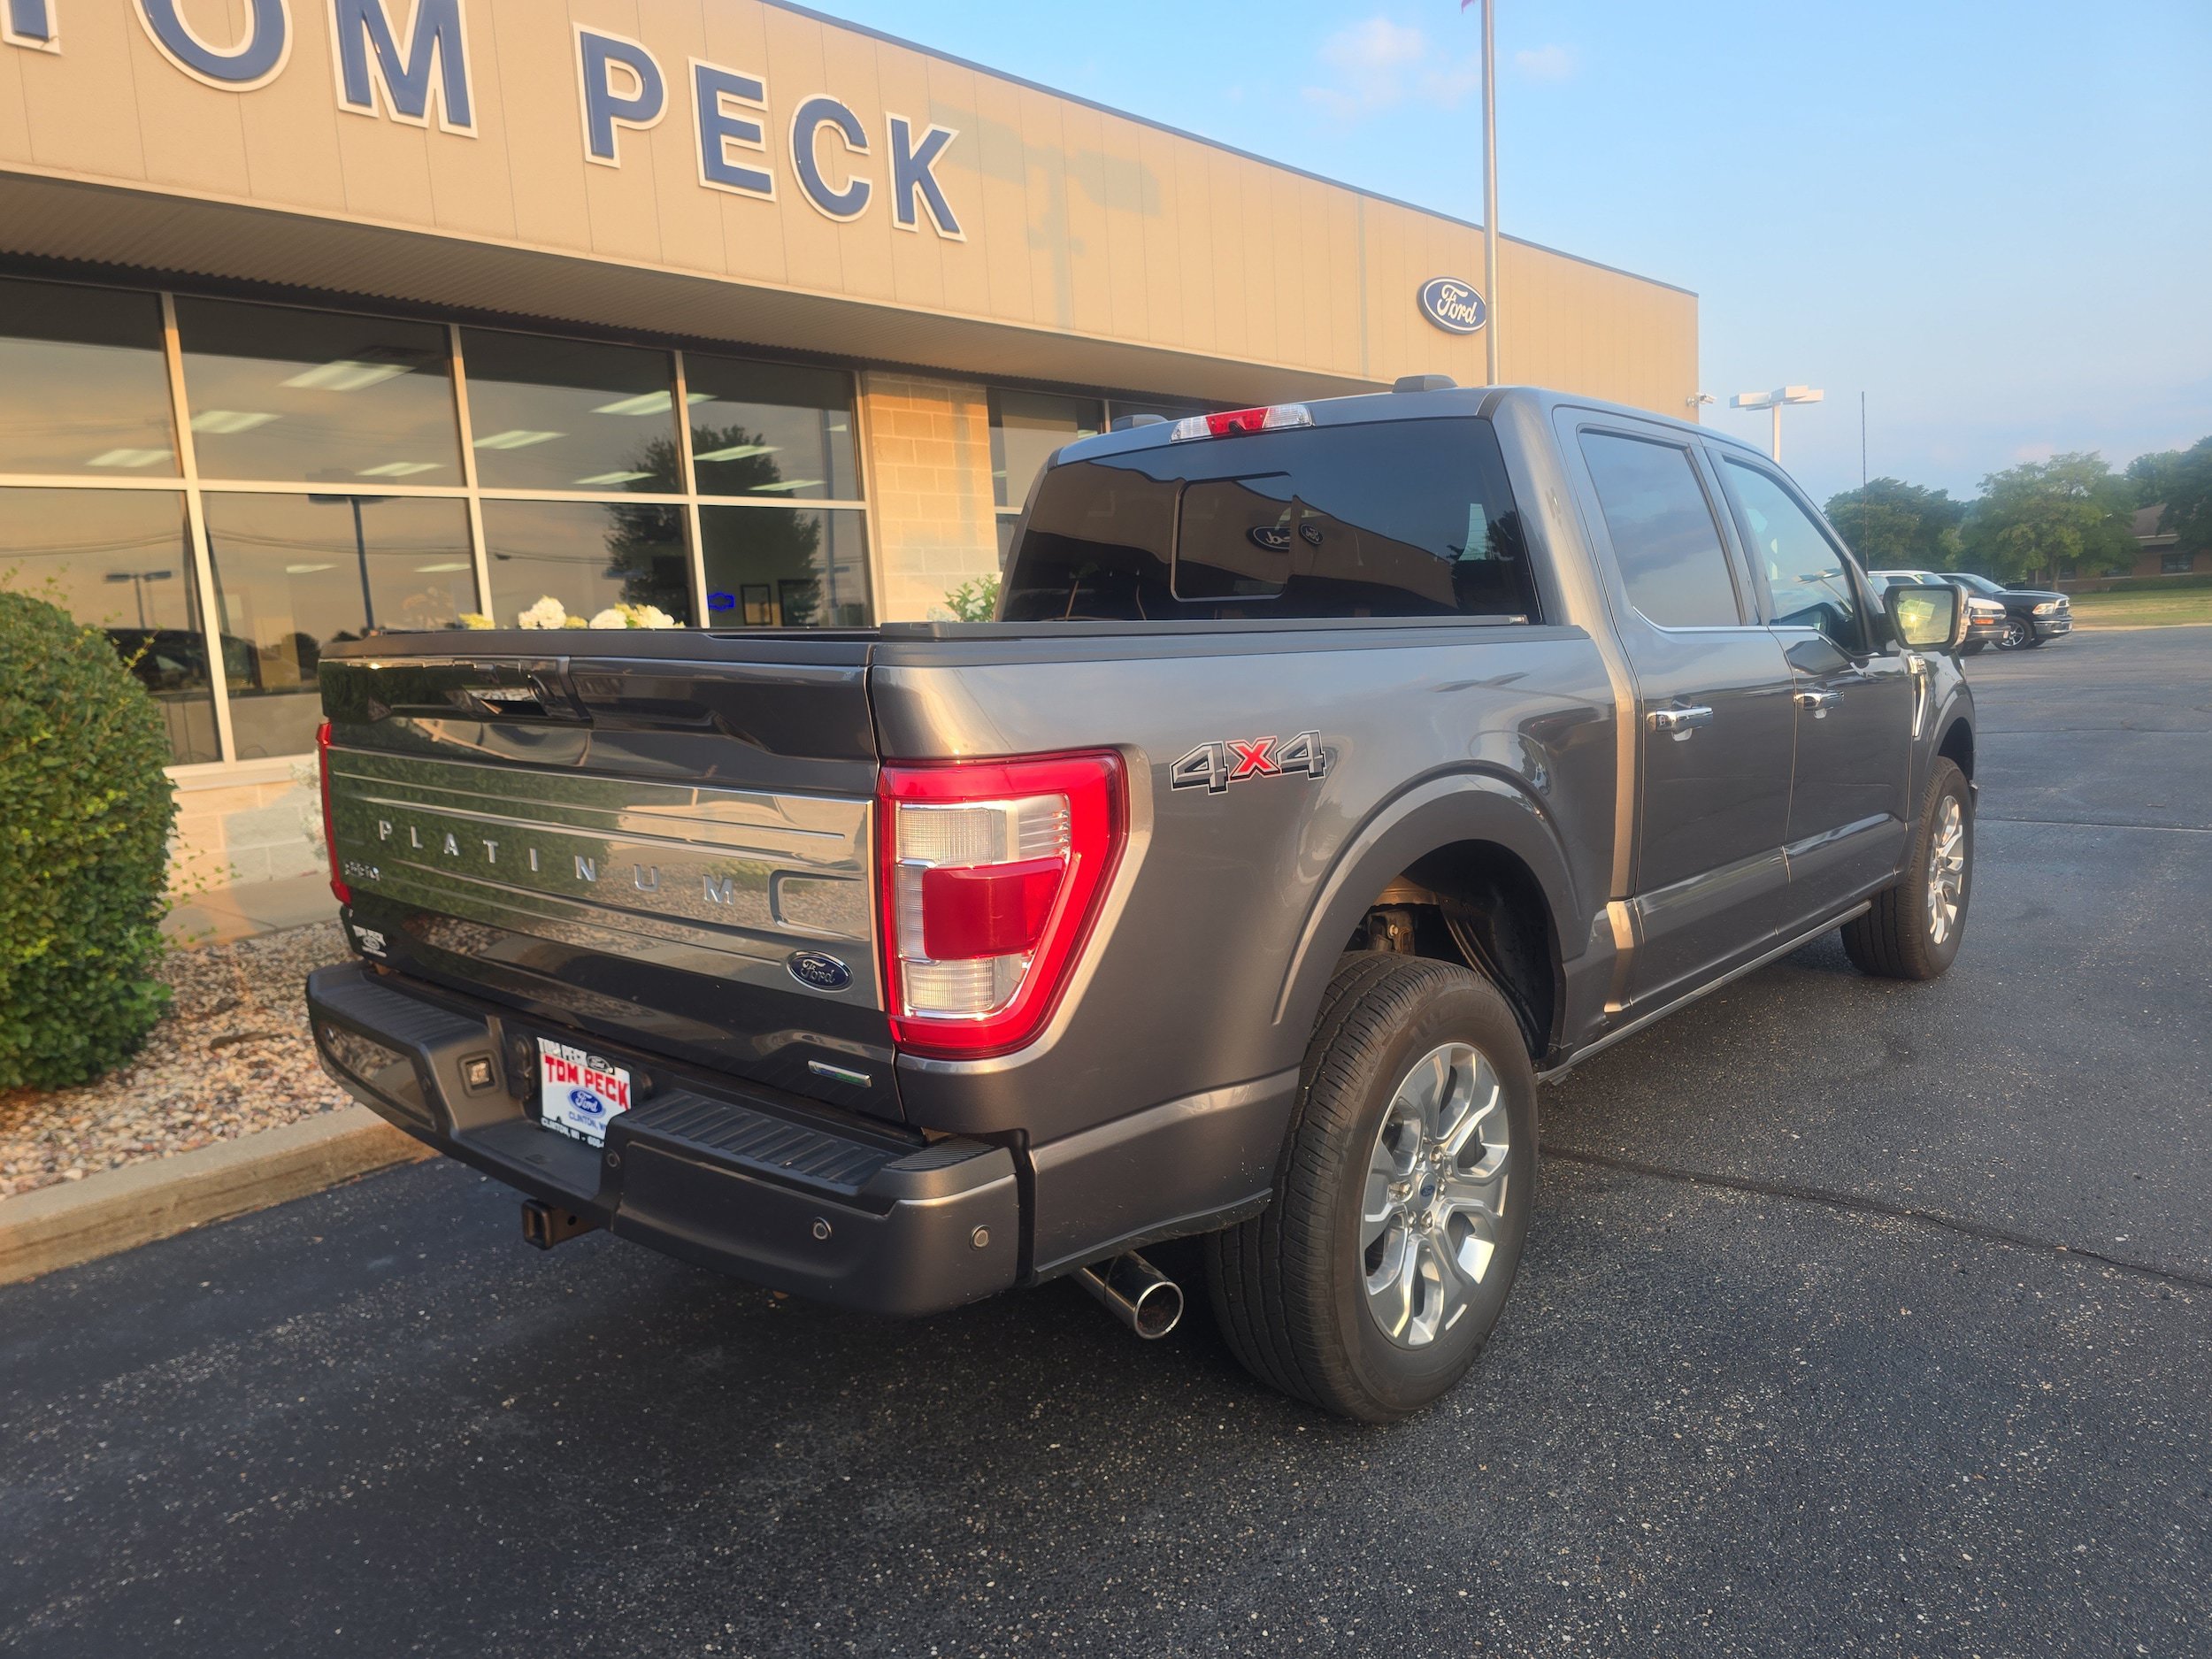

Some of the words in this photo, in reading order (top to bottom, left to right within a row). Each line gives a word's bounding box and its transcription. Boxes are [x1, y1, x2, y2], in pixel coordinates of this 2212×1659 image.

[0, 0, 479, 139] OM
[573, 22, 966, 242] PECK
[1437, 284, 1477, 325] Ford
[378, 819, 734, 906] PLATINUM
[800, 958, 836, 984] Ford
[545, 1055, 580, 1086] TOM
[585, 1069, 629, 1110] PECK
[574, 1092, 599, 1112] Ford
